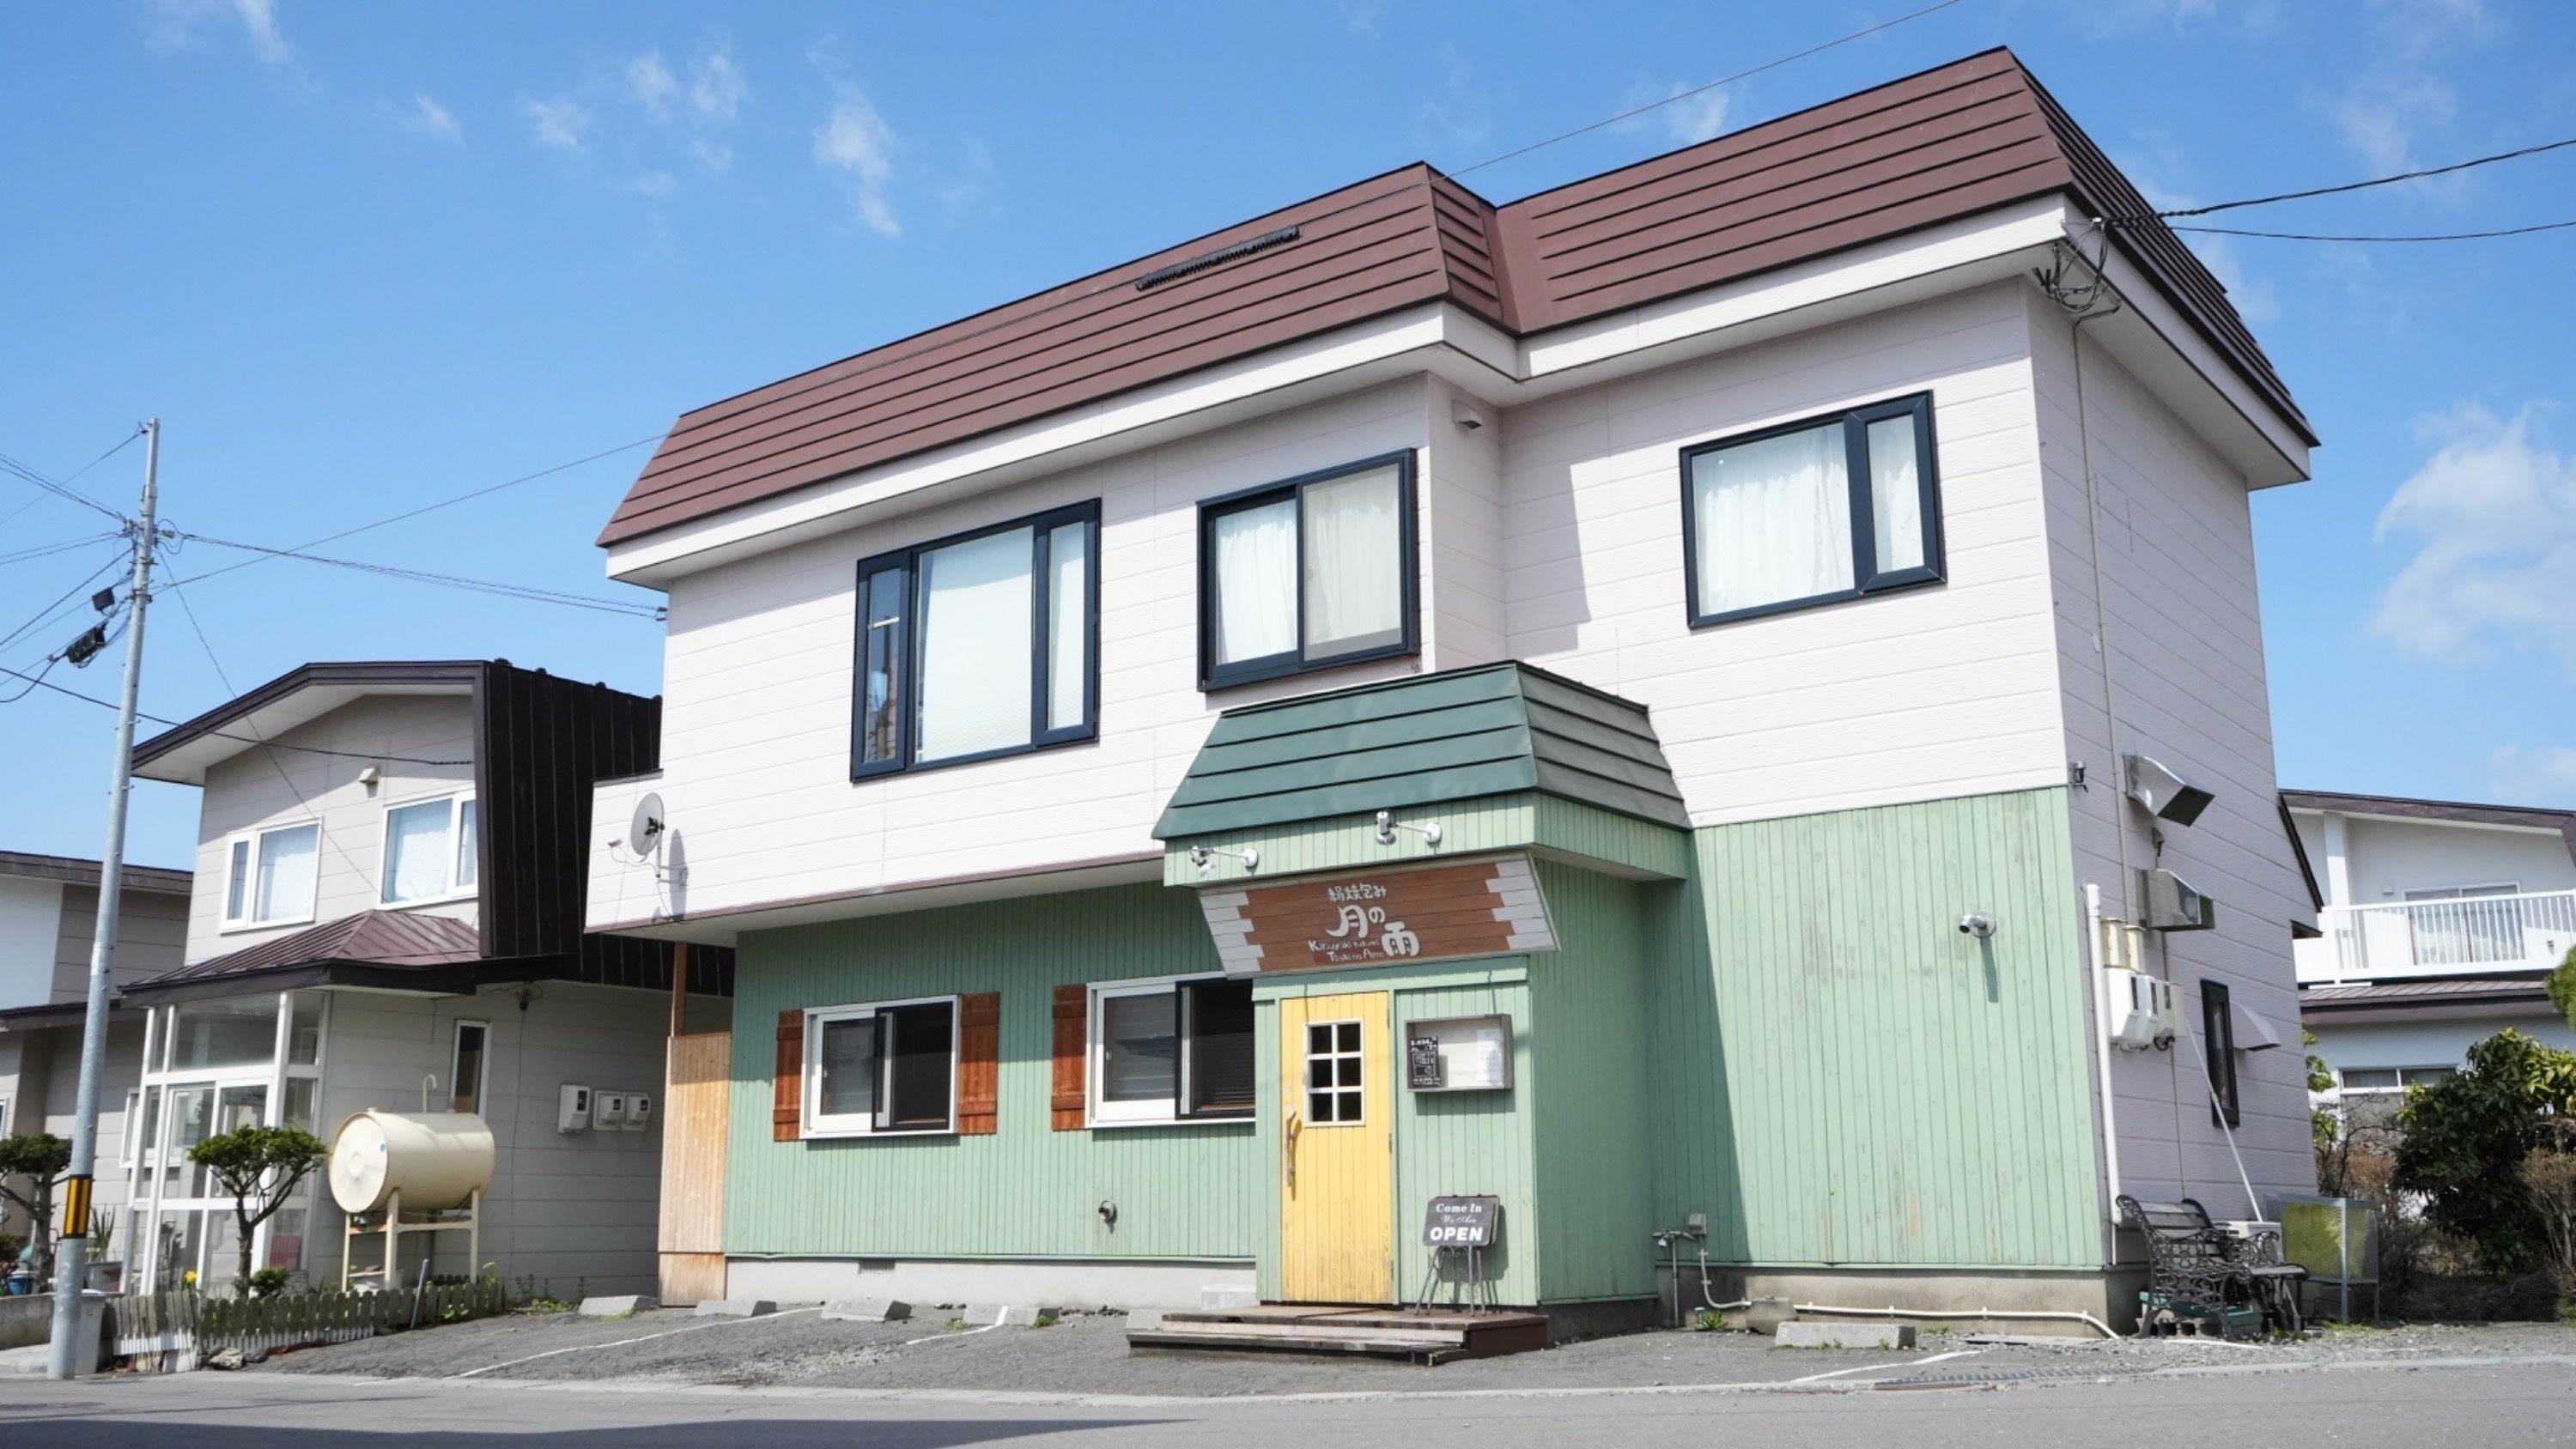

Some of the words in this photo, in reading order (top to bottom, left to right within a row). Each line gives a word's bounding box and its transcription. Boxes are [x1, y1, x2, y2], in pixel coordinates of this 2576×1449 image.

[1326, 905, 1419, 956] 月の雨
[1436, 1203, 1467, 1213] Come
[1470, 1203, 1481, 1213] In
[1441, 1214, 1455, 1223] We
[1455, 1214, 1477, 1223] Are
[1431, 1227, 1483, 1241] OPEN
